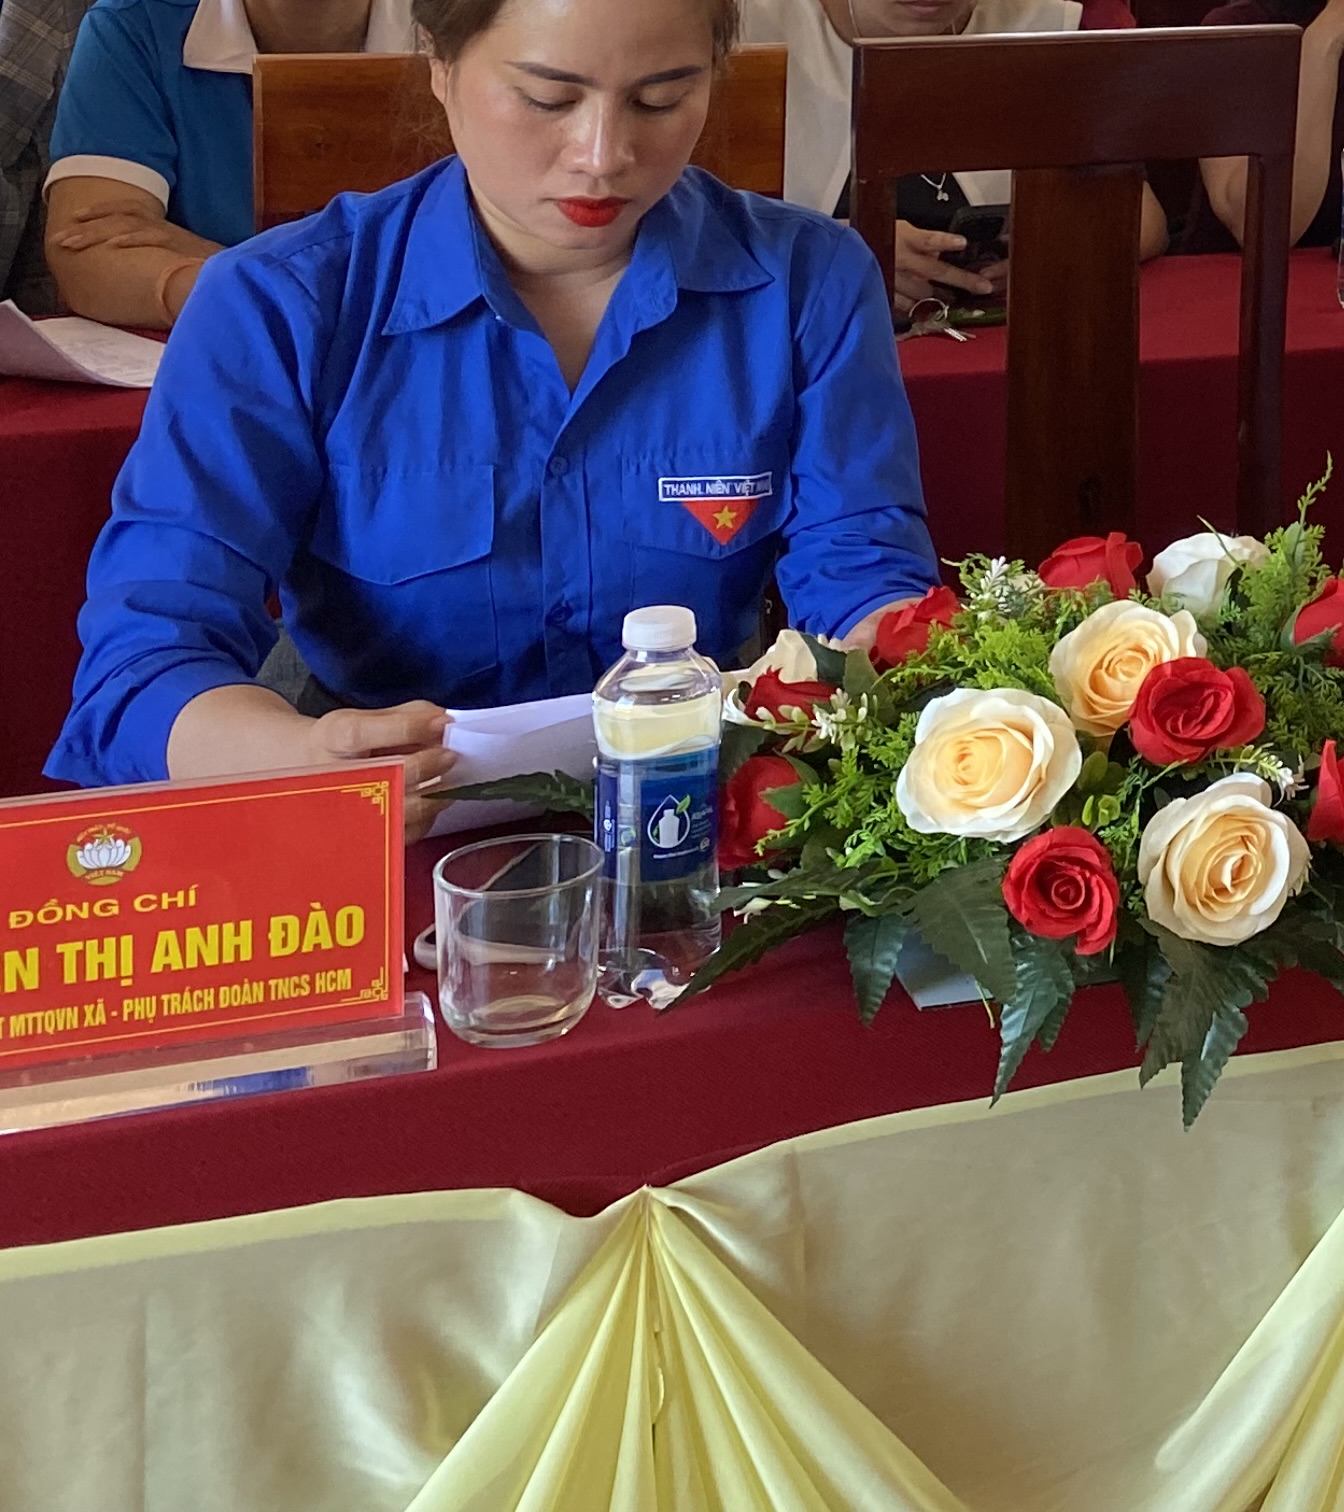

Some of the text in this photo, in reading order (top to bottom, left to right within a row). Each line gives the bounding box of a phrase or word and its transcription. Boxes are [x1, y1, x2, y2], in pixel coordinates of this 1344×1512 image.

[663, 483, 701, 496] THANH
[705, 479, 730, 495] NIÊN
[9, 884, 199, 929] ĐỒNG CHÍ
[3, 902, 365, 993] N THỊ ANH ĐÀO
[9, 1006, 79, 1038] MTTQVN
[84, 998, 106, 1028] XÃ
[123, 995, 157, 1024] PHỤ
[161, 986, 215, 1016] TRÁCH
[219, 978, 265, 1009] ĐOÀN
[268, 974, 310, 1001] TNCS
[315, 968, 352, 994] HCM
